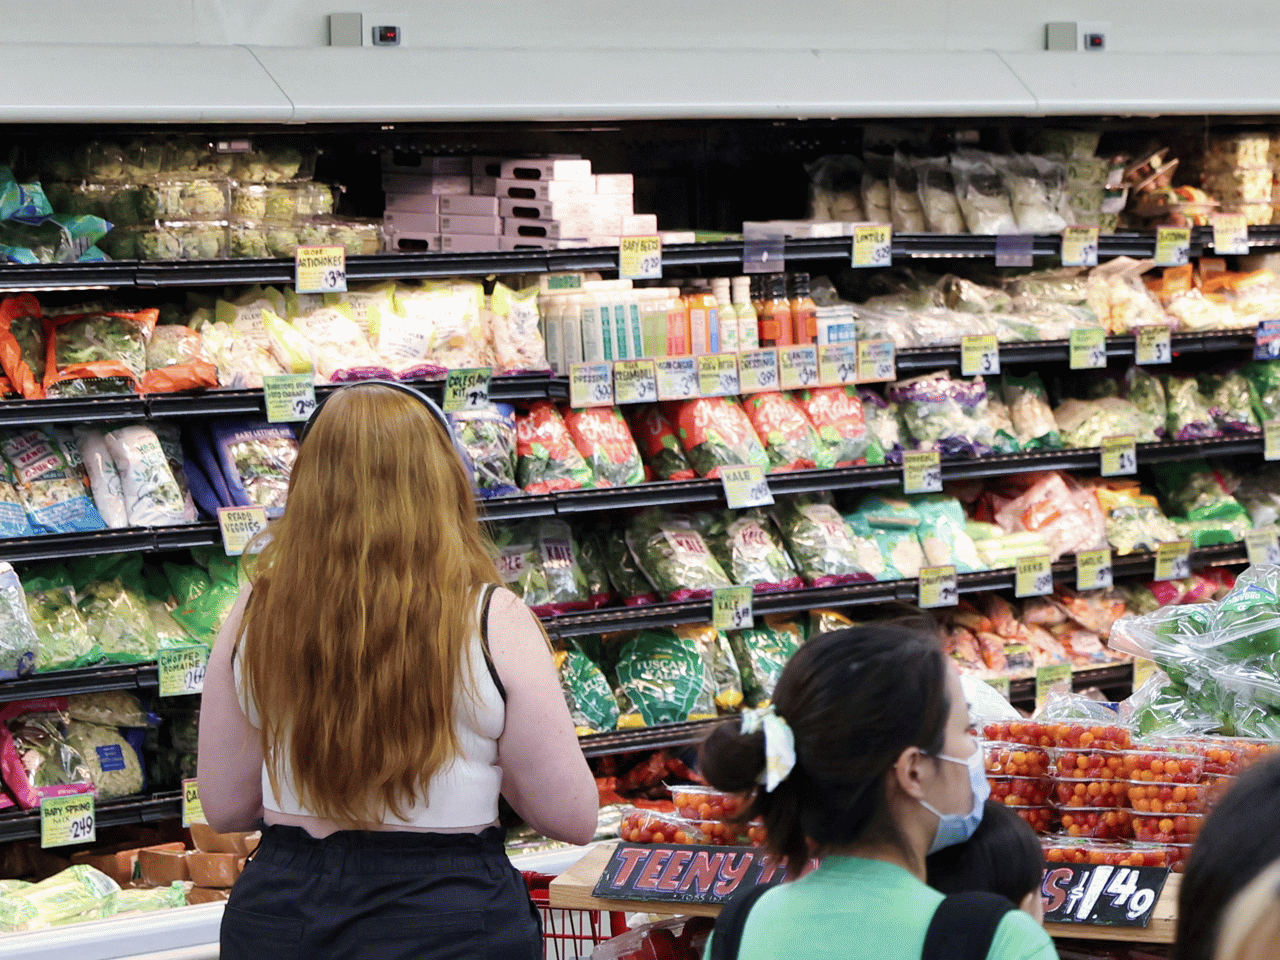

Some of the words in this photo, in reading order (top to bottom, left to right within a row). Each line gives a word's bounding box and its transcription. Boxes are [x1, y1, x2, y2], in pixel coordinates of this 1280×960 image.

[298, 256, 343, 268] ARTICHOKES
[225, 521, 262, 534] VEGGIES
[161, 652, 200, 667] CHOPPED
[637, 660, 689, 673] TUSCAN
[163, 660, 201, 674] ROMAINE
[44, 807, 63, 818] BABY
[64, 803, 91, 814] SPRING
[610, 848, 754, 897] TEENY
